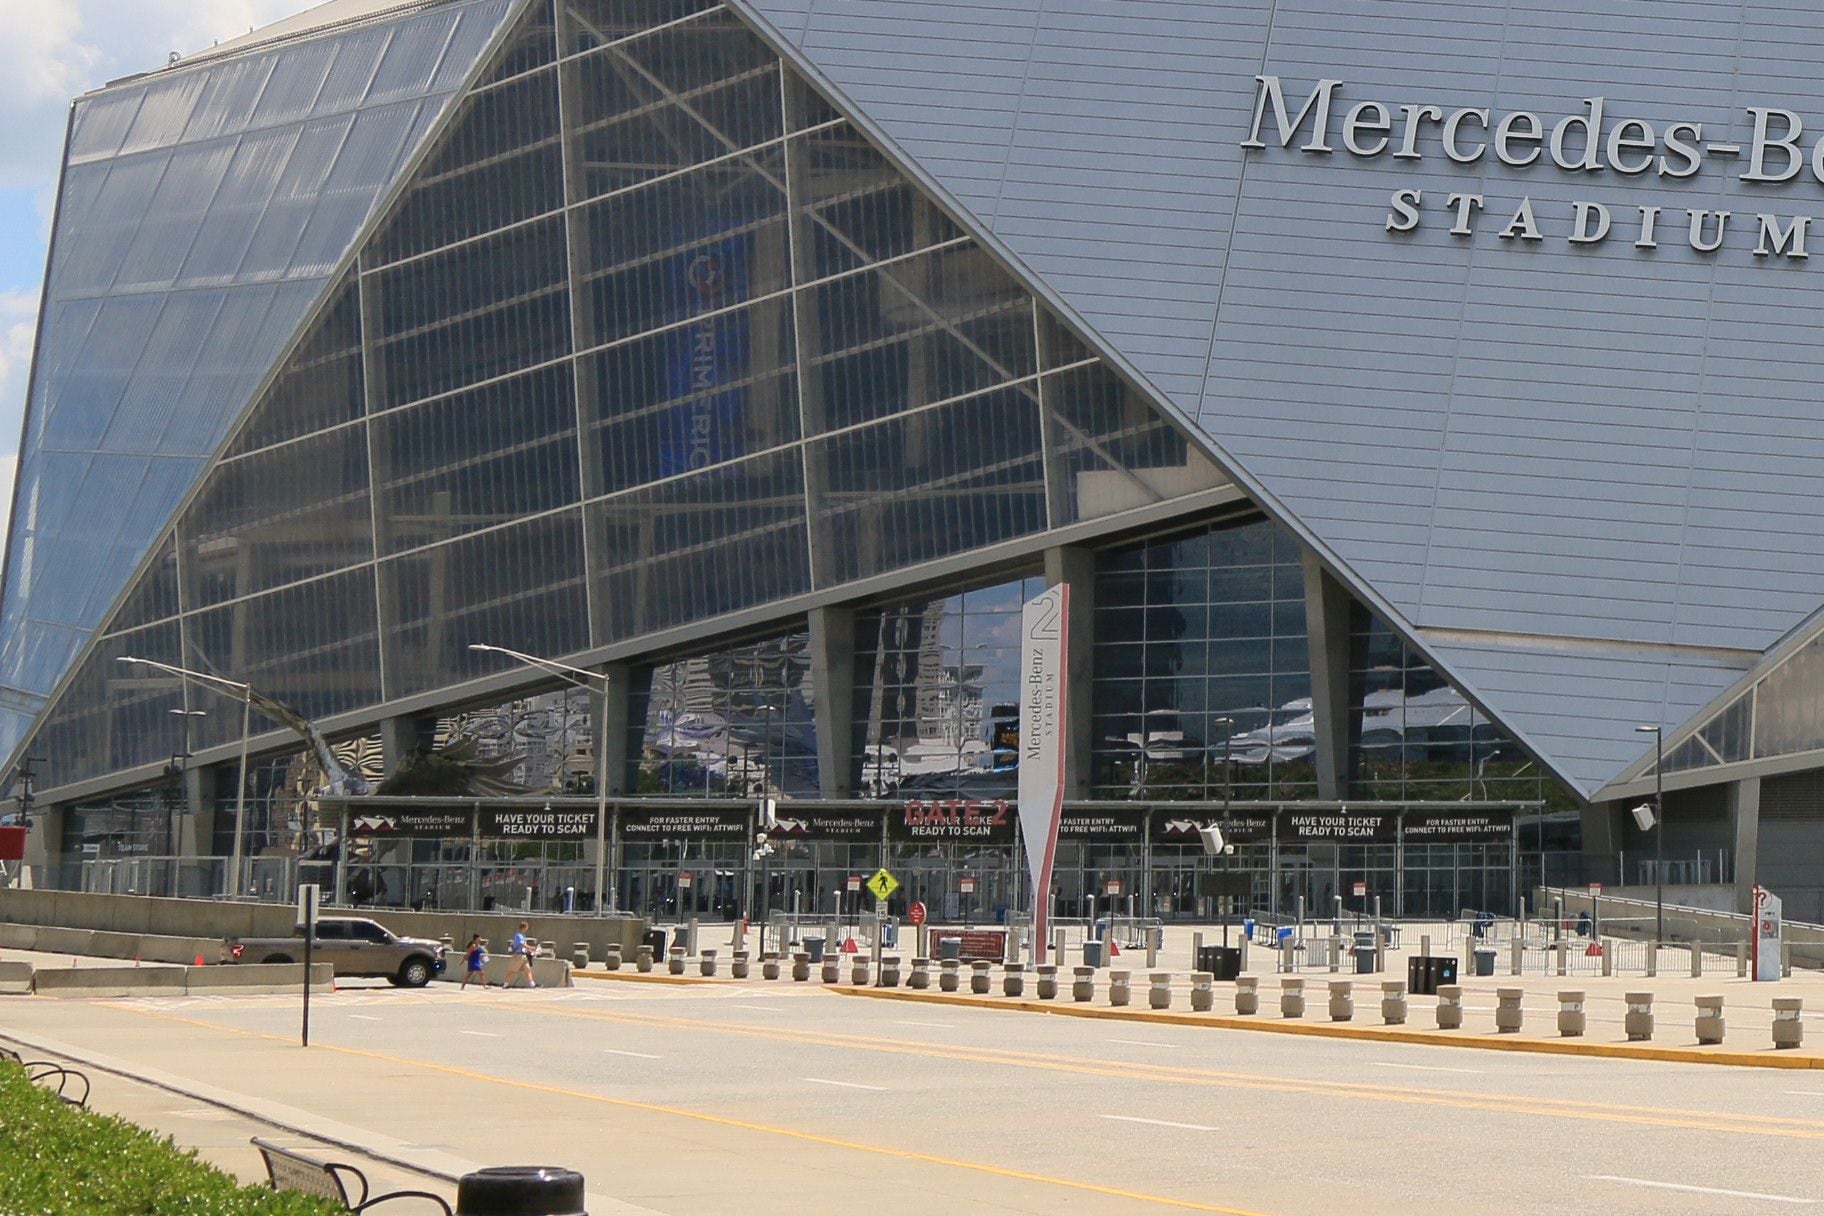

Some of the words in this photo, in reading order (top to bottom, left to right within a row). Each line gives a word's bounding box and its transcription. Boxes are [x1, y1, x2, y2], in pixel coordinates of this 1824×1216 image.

[1385, 188, 1812, 259] STADIUM
[1027, 648, 1043, 761] Mercedes-Benz
[1045, 673, 1054, 736] STADIUM
[905, 800, 980, 825] GATE
[992, 799, 1008, 825] 2
[400, 815, 465, 825] Mercedes-Benz
[495, 814, 523, 824] HAVE
[525, 814, 554, 824] YOUR
[557, 814, 595, 824] TICKET
[813, 818, 874, 827] Mercedes-Benz
[1291, 816, 1317, 826] HAVE
[1319, 817, 1346, 826] YOUR
[1347, 817, 1382, 826] TICKET
[503, 825, 538, 834] READY
[540, 825, 555, 834] TO
[557, 825, 587, 834] SCAN
[911, 826, 946, 835] READY
[948, 826, 960, 835] TO
[963, 826, 991, 835] SCAN
[1298, 826, 1332, 836] READY
[1334, 826, 1345, 835] TO
[1347, 826, 1374, 836] SCAN
[1405, 826, 1436, 834] CONNECT
